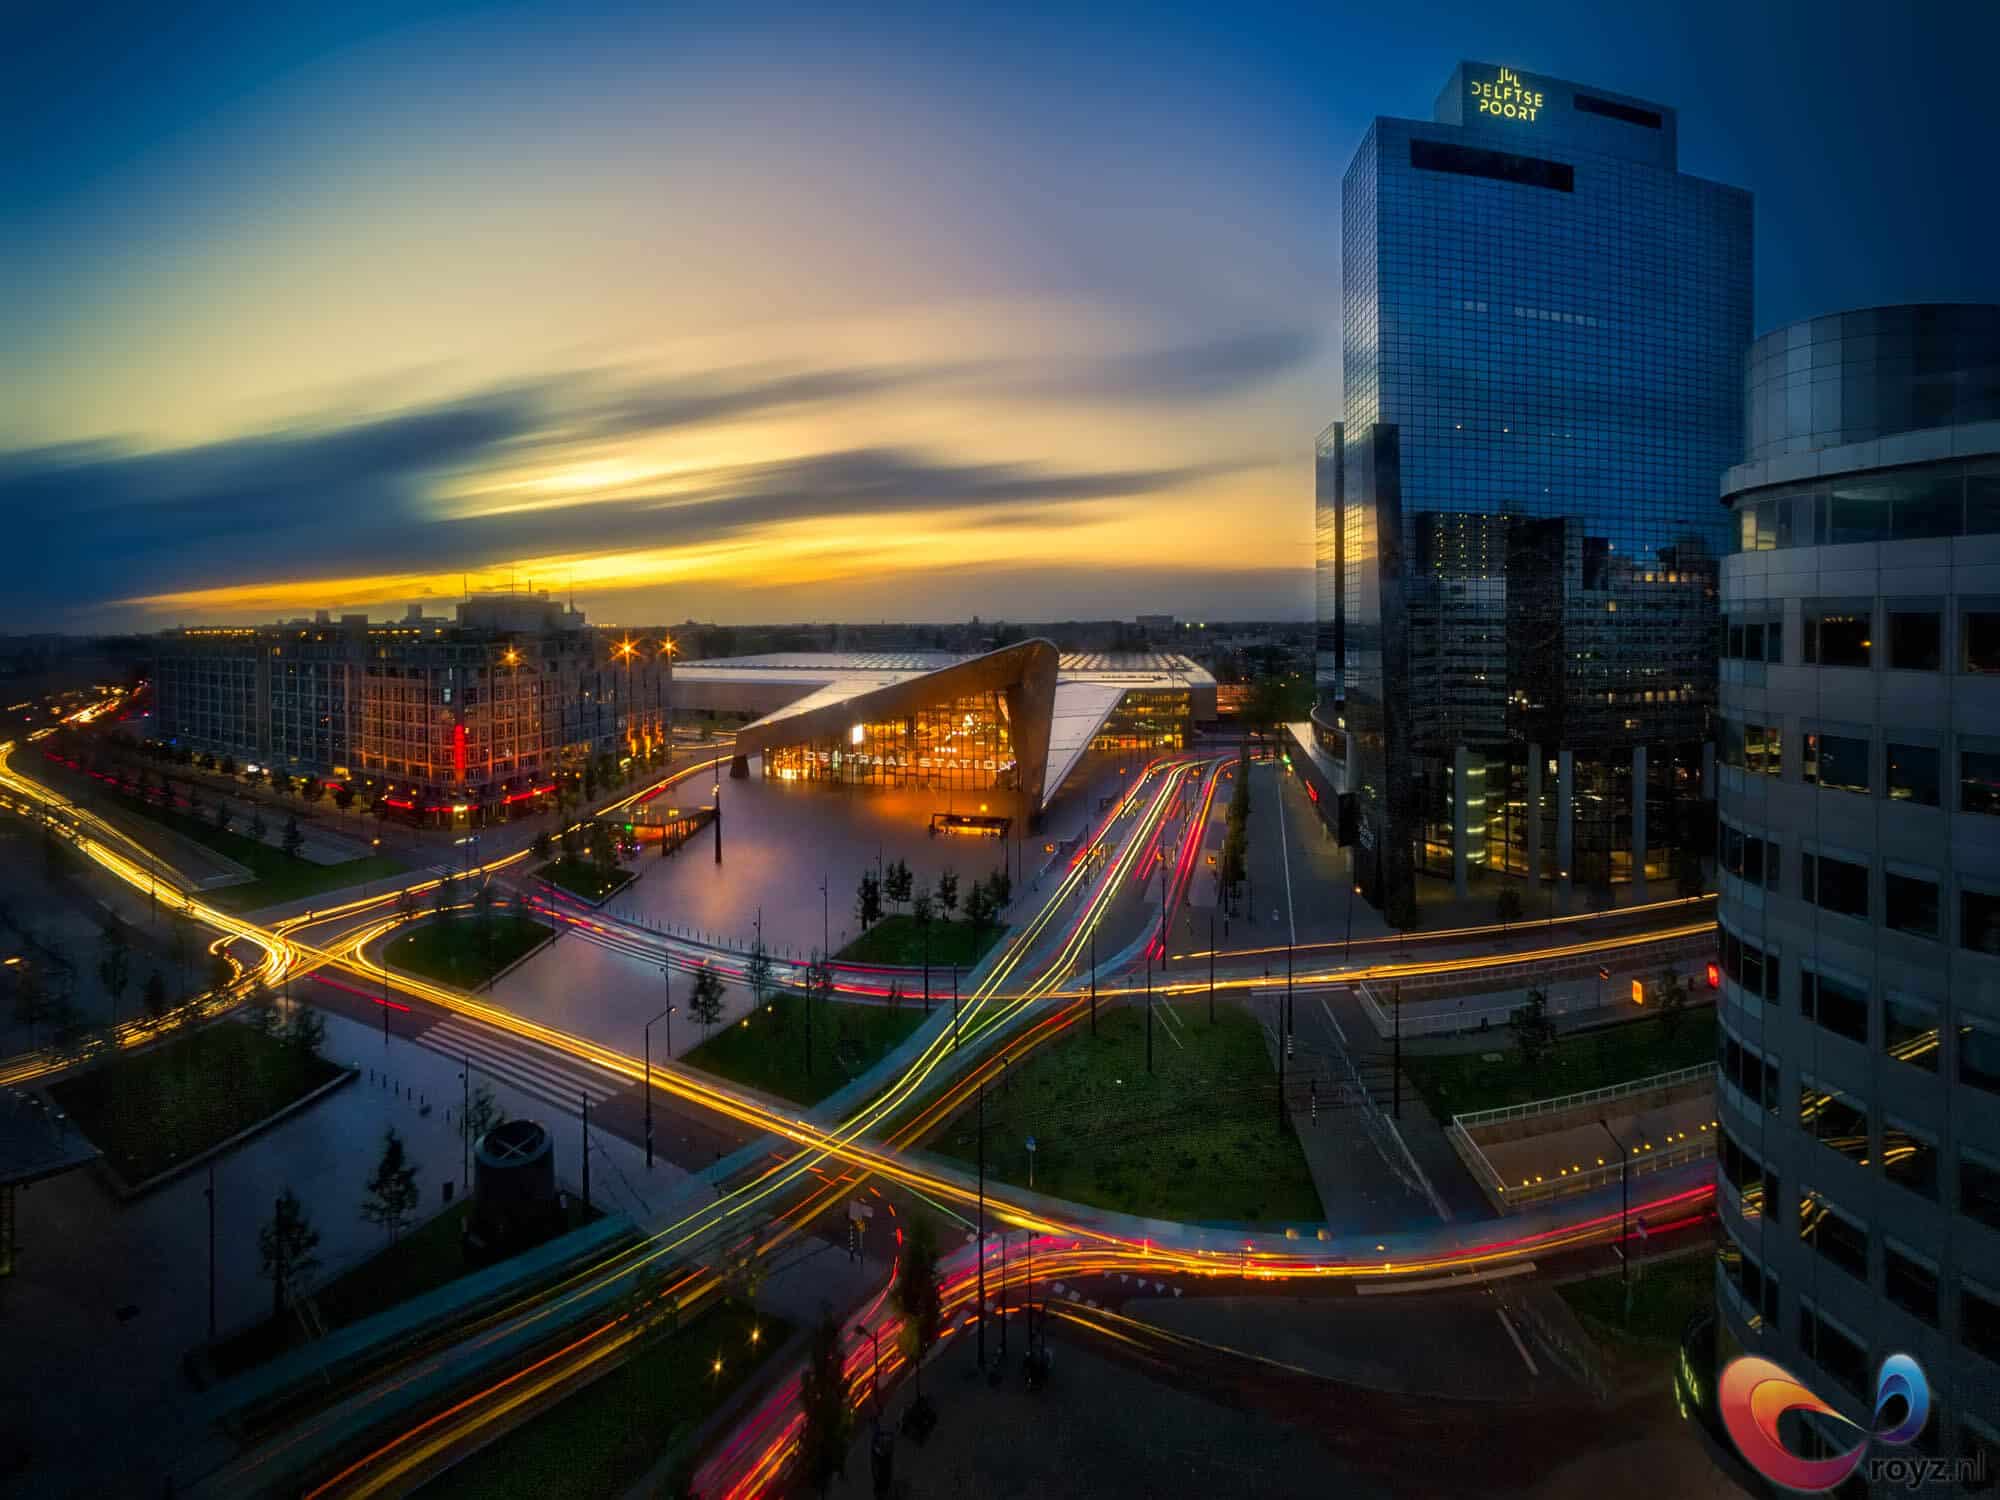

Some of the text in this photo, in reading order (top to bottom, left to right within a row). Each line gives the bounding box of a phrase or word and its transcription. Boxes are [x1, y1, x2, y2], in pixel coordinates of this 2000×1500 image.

[1471, 81, 1543, 107] DELFTSE
[1479, 98, 1537, 121] POORT
[919, 757, 1014, 771] STATION
